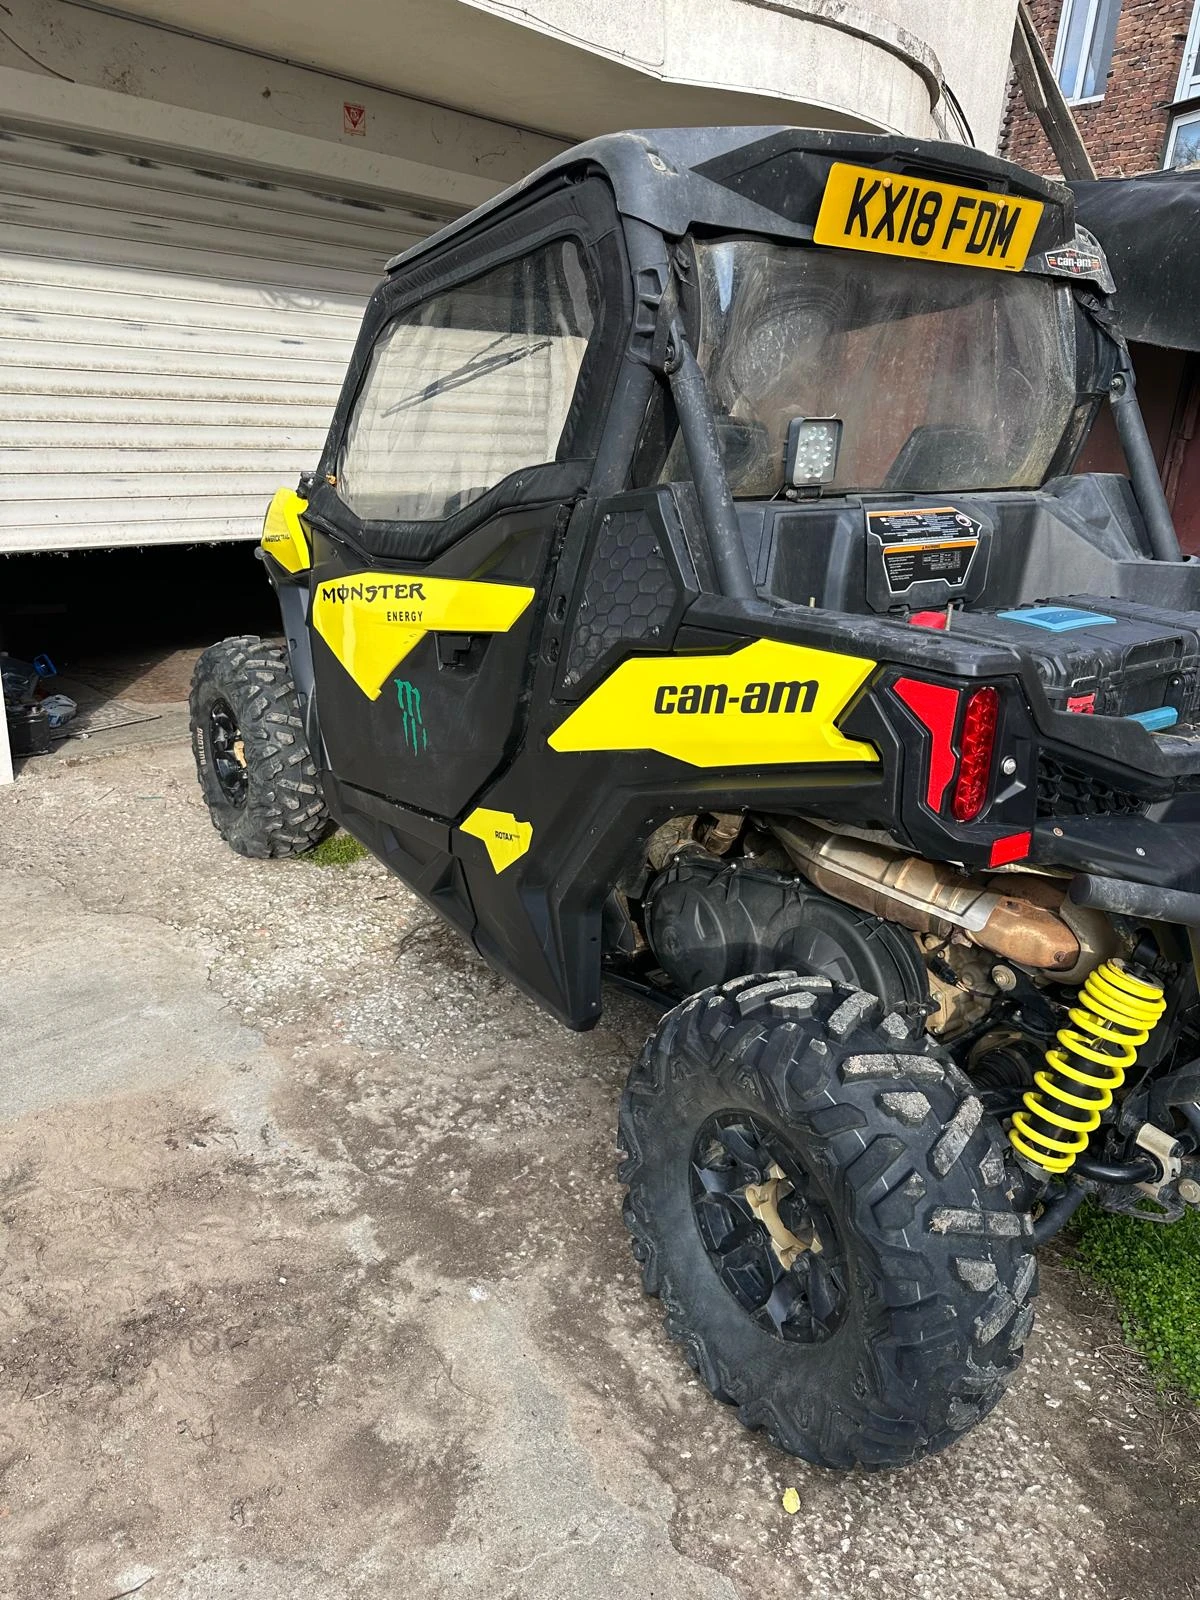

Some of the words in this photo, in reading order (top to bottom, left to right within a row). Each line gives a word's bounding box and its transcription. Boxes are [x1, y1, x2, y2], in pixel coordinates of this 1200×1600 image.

[844, 177, 943, 246] KX18
[941, 195, 1022, 259] FDM
[1057, 256, 1092, 268] can-am
[387, 610, 423, 622] ENERGY
[654, 680, 820, 715] can-am
[495, 830, 514, 842] ROTAX
